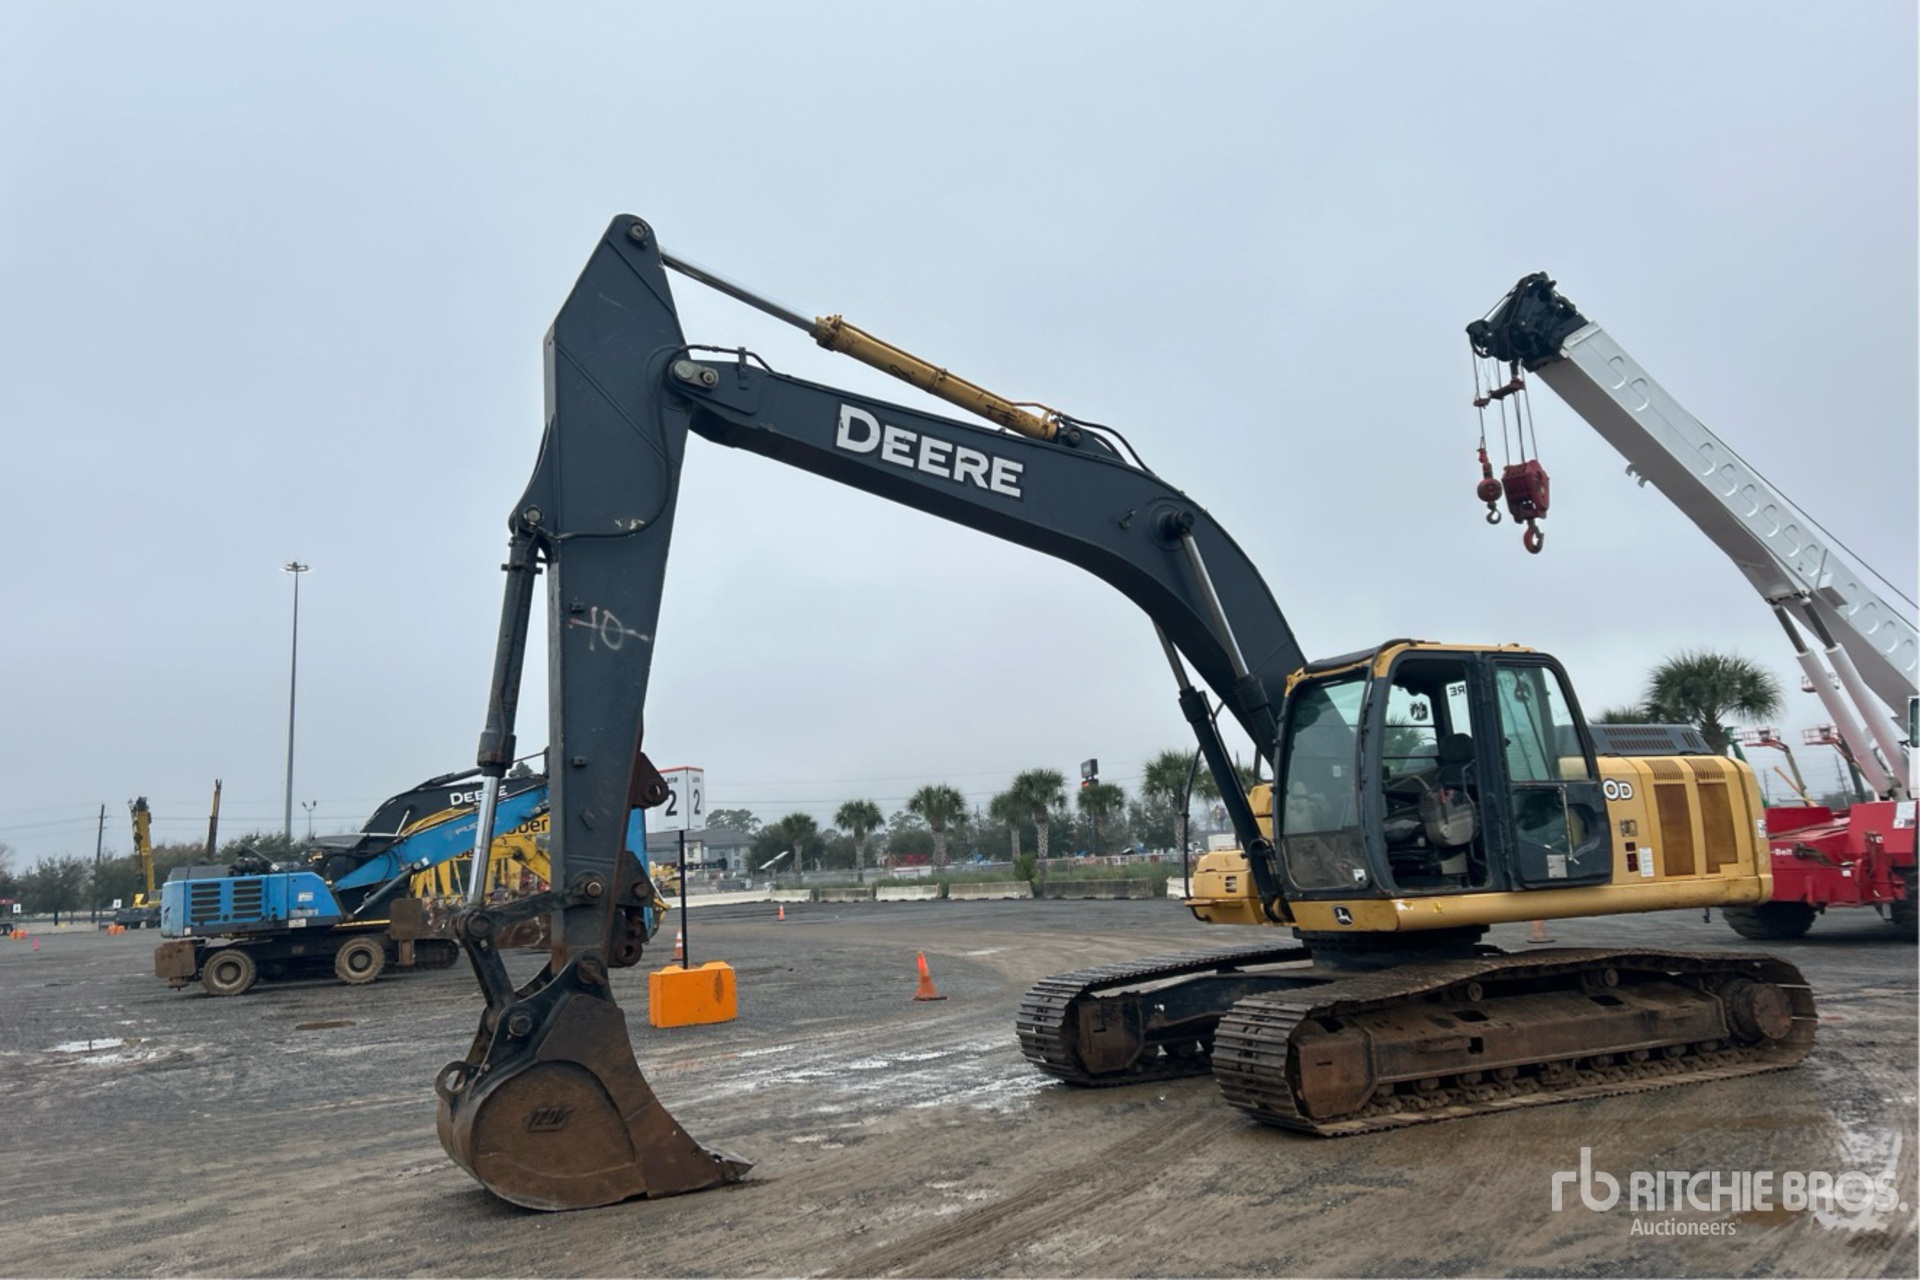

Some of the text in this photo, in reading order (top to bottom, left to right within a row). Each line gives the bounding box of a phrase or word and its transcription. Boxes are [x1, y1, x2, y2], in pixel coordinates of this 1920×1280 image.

[836, 403, 1024, 498] DEERE
[450, 785, 508, 806] DEEE
[665, 789, 677, 817] 2
[693, 788, 701, 815] 2
